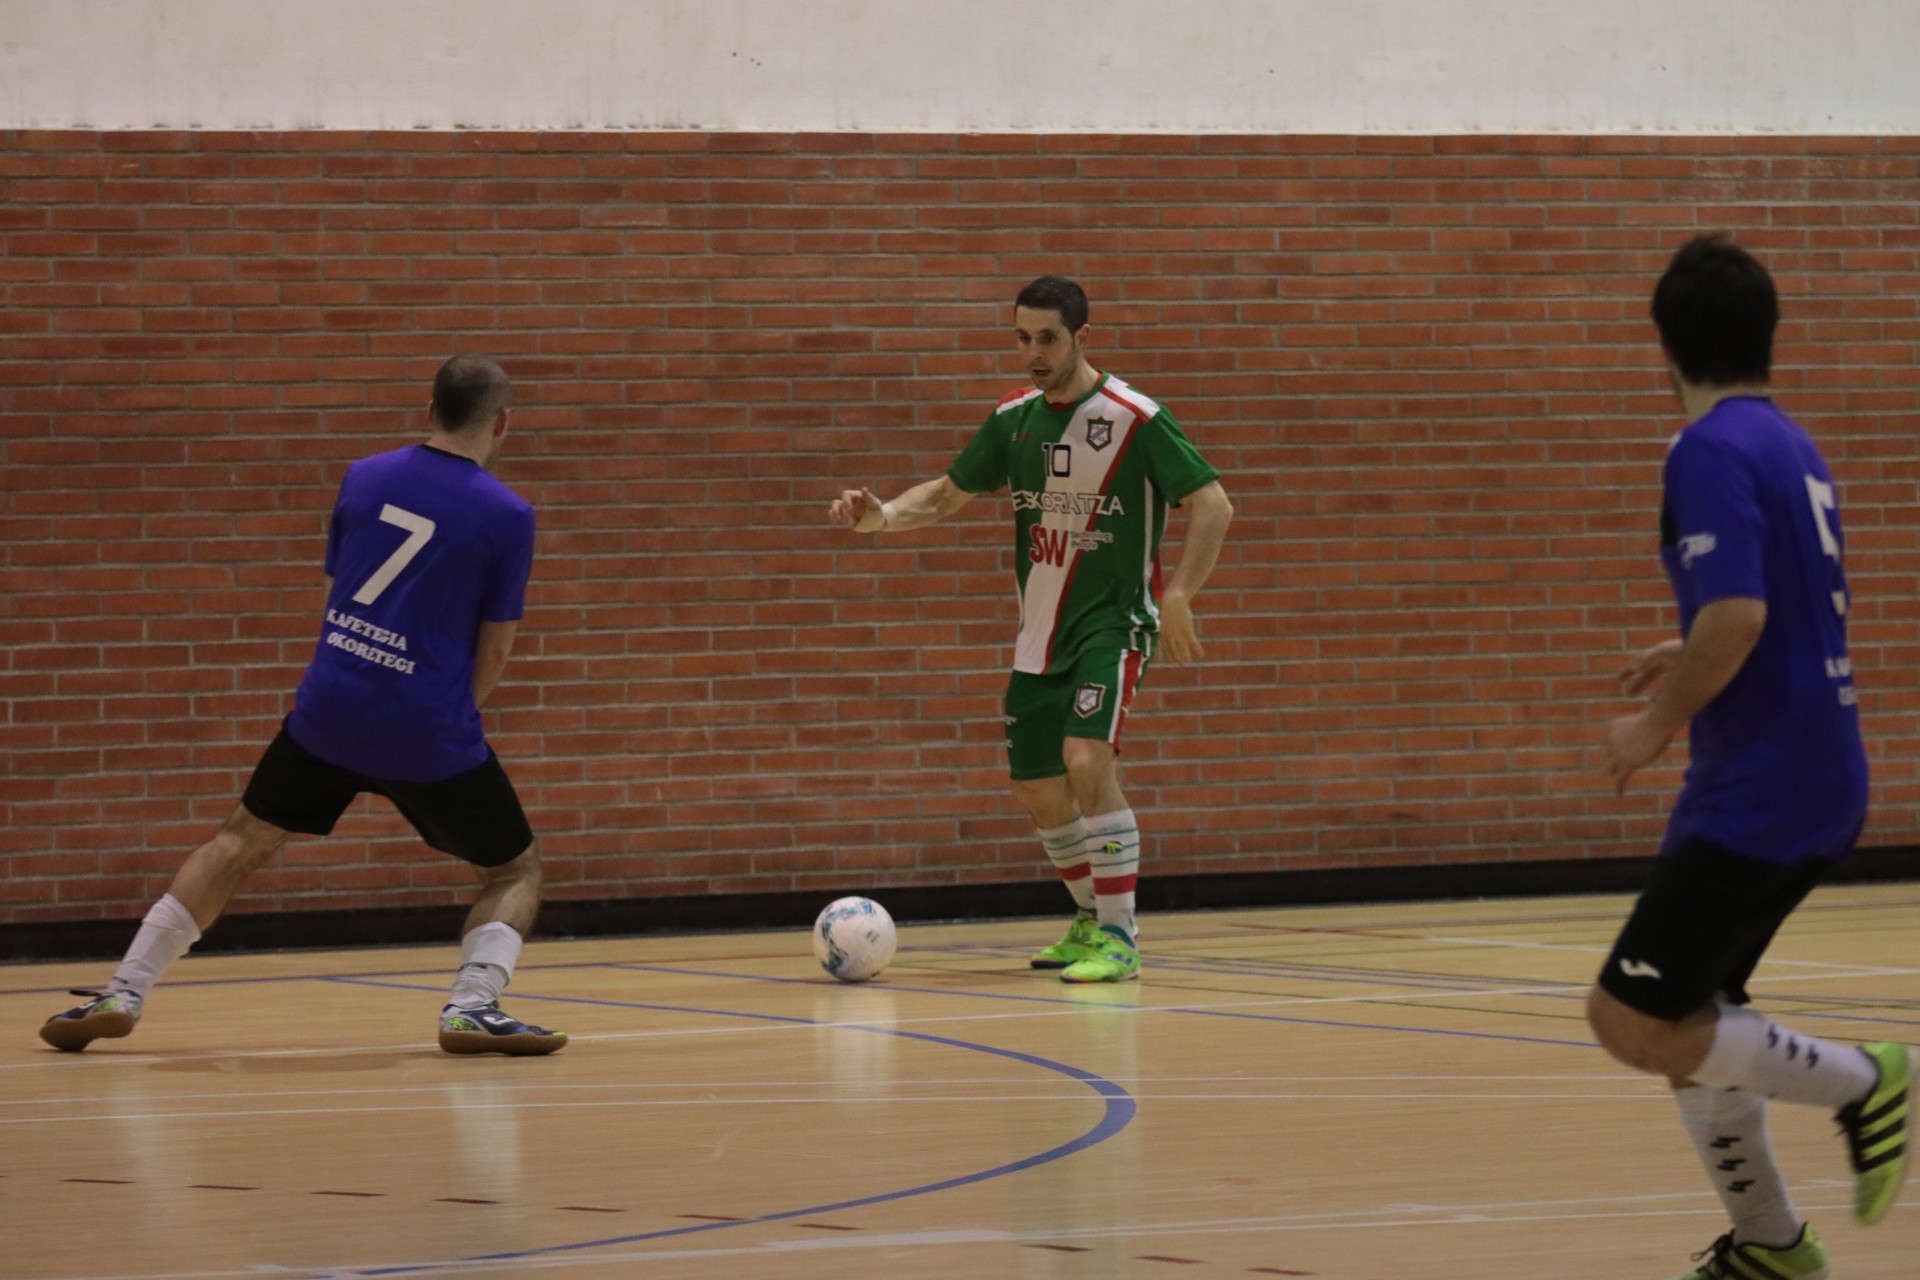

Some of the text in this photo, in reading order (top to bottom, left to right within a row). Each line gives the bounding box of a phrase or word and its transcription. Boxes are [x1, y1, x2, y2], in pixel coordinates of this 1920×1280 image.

[1042, 442, 1072, 478] 10
[352, 503, 437, 606] 7
[1029, 523, 1069, 568] SW
